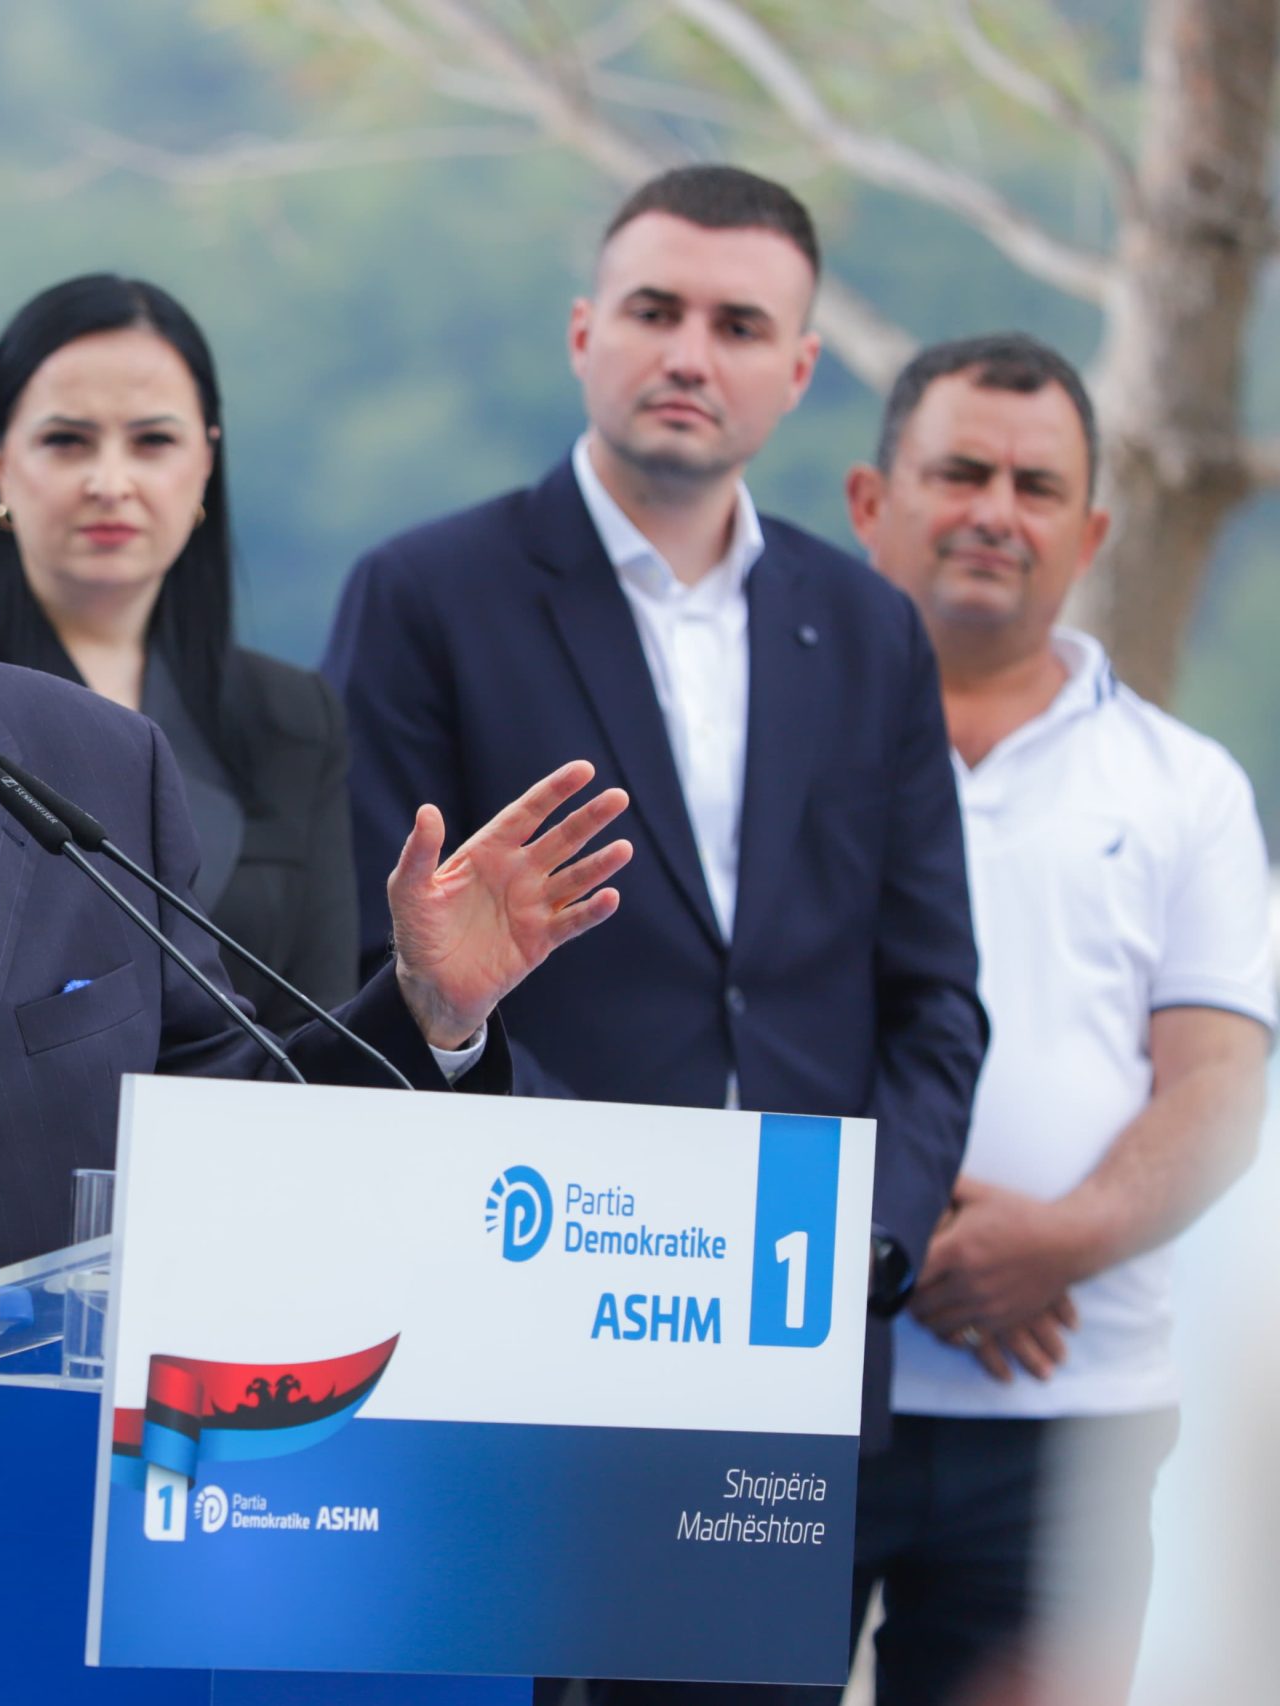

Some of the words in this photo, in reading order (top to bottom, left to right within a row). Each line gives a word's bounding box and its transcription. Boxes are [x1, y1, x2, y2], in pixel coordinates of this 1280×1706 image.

[565, 1183, 634, 1216] Partia
[564, 1221, 726, 1259] Demokratike
[775, 1231, 809, 1329] 1
[591, 1292, 721, 1344] ASHM
[232, 1493, 267, 1510] Partia
[723, 1468, 827, 1506] Shqipëria
[158, 1485, 174, 1531] 1
[232, 1513, 310, 1530] Demokratike
[316, 1506, 379, 1532] ASHM
[677, 1511, 825, 1545] Madhështore
